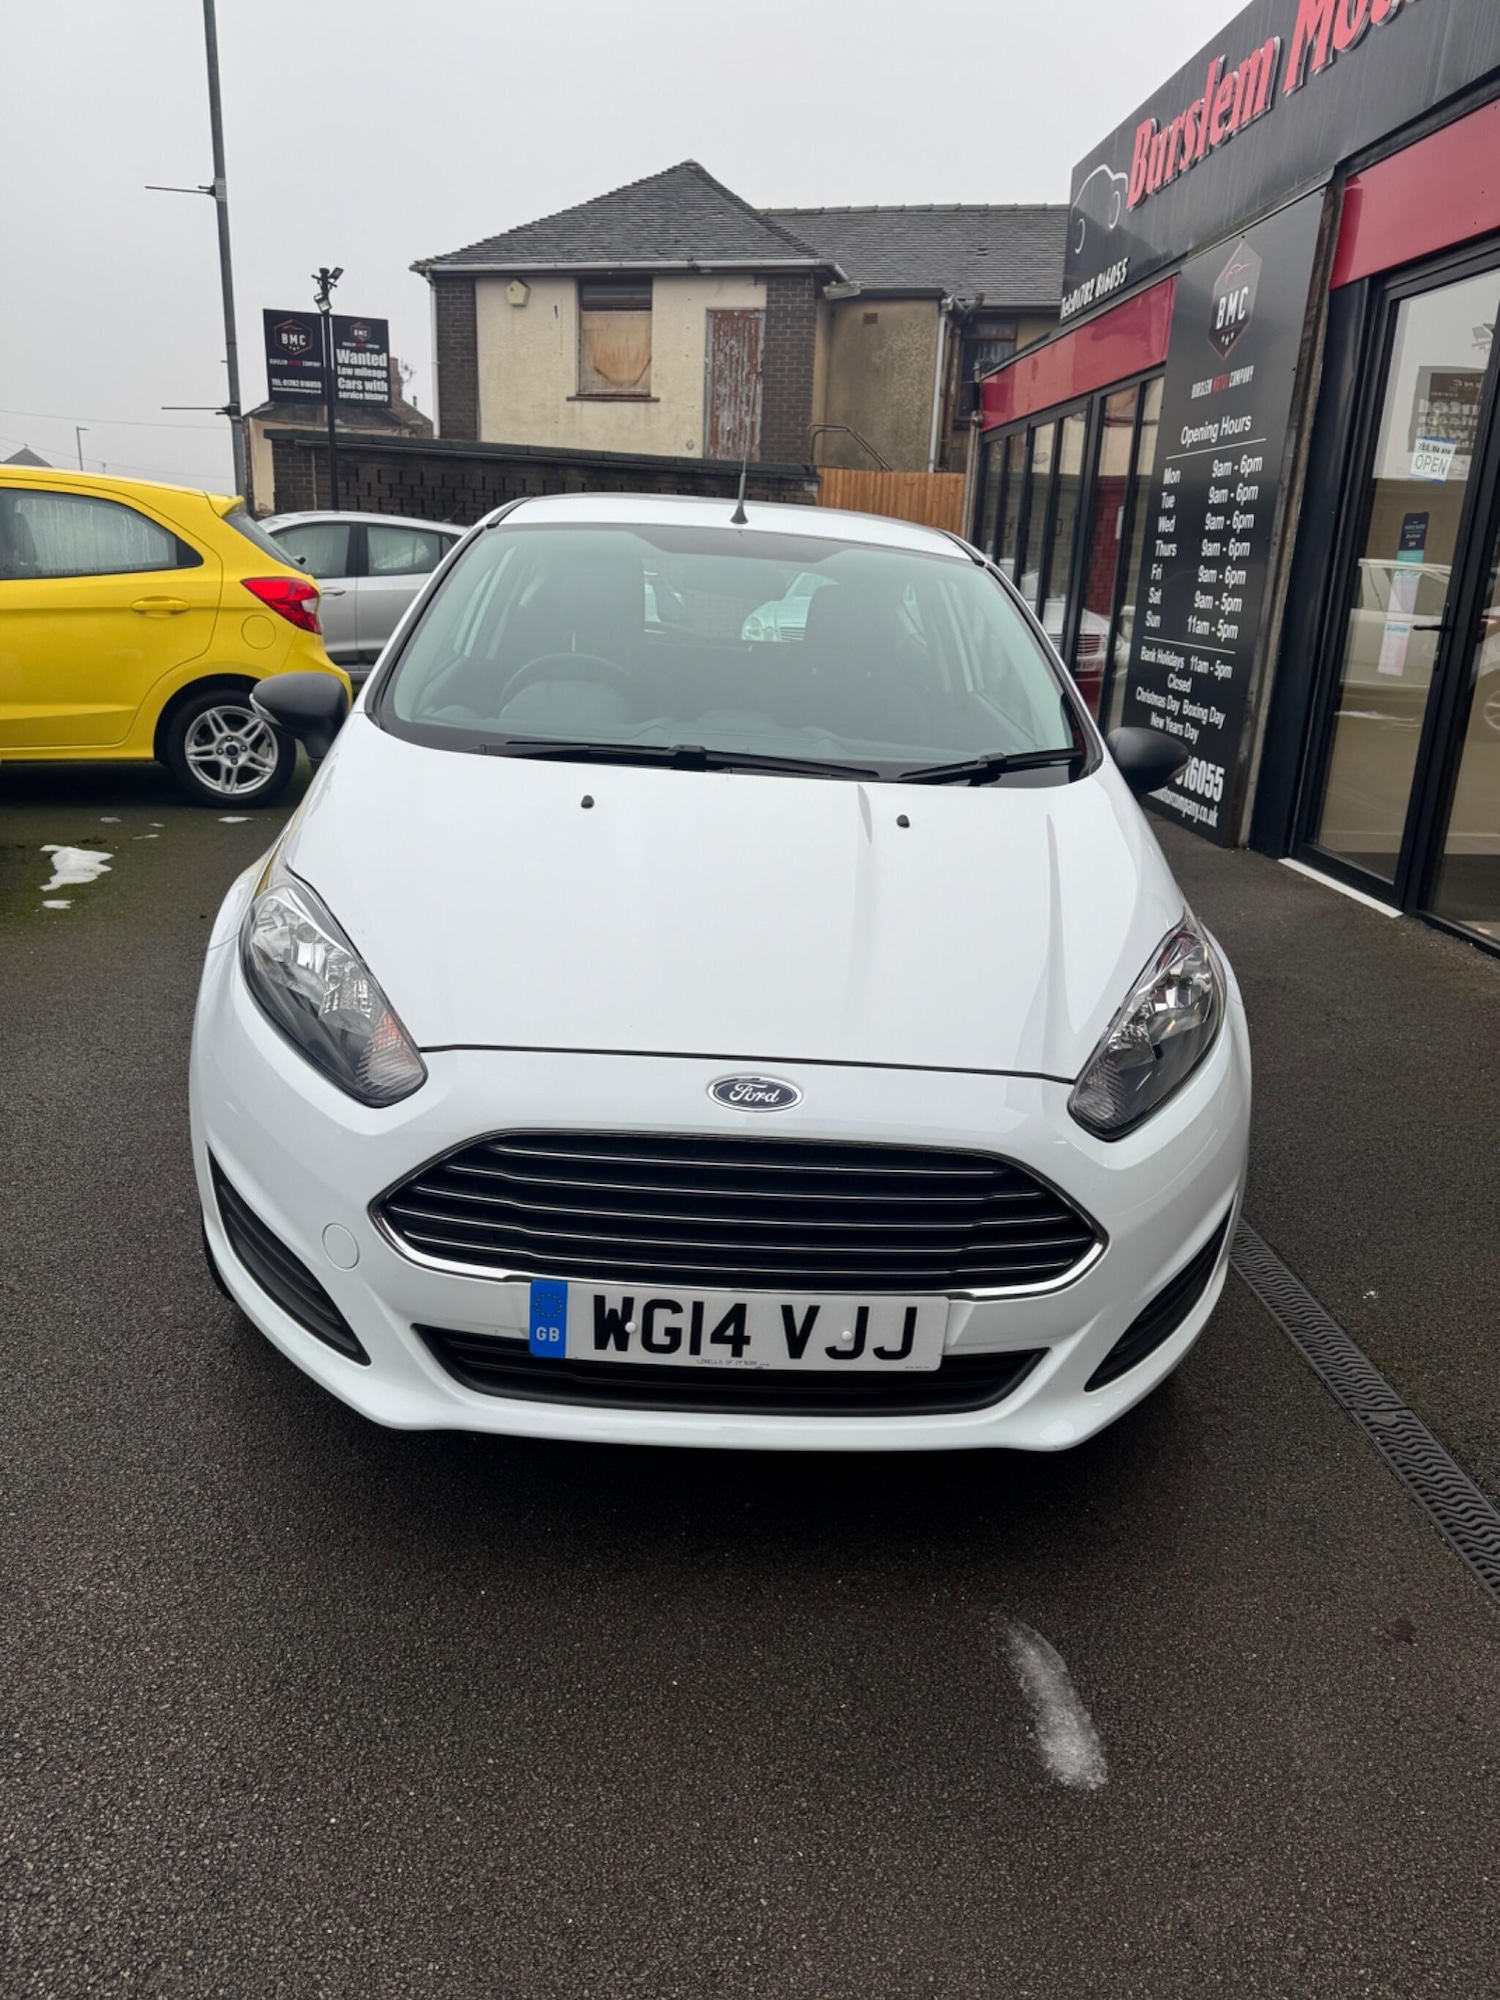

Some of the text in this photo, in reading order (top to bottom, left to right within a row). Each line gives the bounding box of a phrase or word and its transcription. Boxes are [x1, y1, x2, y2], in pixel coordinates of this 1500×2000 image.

[1126, 36, 1279, 211] Burslem
[1216, 286, 1249, 330] BMC
[281, 333, 306, 346] BMC
[353, 329, 368, 337] BMC
[336, 349, 387, 366] Wanted
[337, 365, 387, 379] Low mileage
[1229, 365, 1254, 388] COMPANY
[338, 377, 388, 392] Cars with
[338, 390, 388, 403] service history
[1181, 416, 1252, 448] Opening Hours
[1163, 467, 1181, 485] Mon
[1212, 459, 1232, 478] 9am
[1240, 454, 1263, 478] 6pm
[1415, 453, 1449, 475] OPEN
[1161, 491, 1175, 509] Tue
[1208, 486, 1228, 504] 9am
[1236, 482, 1259, 506] 6pm
[1158, 515, 1176, 533] Wed
[1205, 512, 1225, 531] 9am
[1232, 510, 1254, 534] 6pm
[1155, 540, 1177, 557] Thurs
[1201, 538, 1221, 557] 9am
[1228, 537, 1250, 561] 6pm
[1151, 564, 1163, 580] Fri
[1198, 565, 1217, 583] 9am
[1224, 565, 1247, 588] 6pm
[1148, 586, 1162, 604] Sat
[1194, 590, 1213, 609] 9am
[1220, 592, 1243, 615] 5pm
[1145, 610, 1161, 628] Sun
[1187, 615, 1210, 635] 11am
[1216, 618, 1239, 642] 5pm
[1141, 645, 1156, 662] Bank
[1157, 648, 1185, 672] Holidays
[1190, 655, 1209, 674] 11am
[1214, 660, 1233, 680] 5pm
[1167, 673, 1192, 693] Closed
[1136, 686, 1226, 729] Christmas Day Boxing Day
[1150, 712, 1199, 745] New Years Day
[729, 1083, 781, 1103] Ford
[535, 1326, 560, 1342] GB
[593, 1294, 918, 1362] WG14 VJJ
